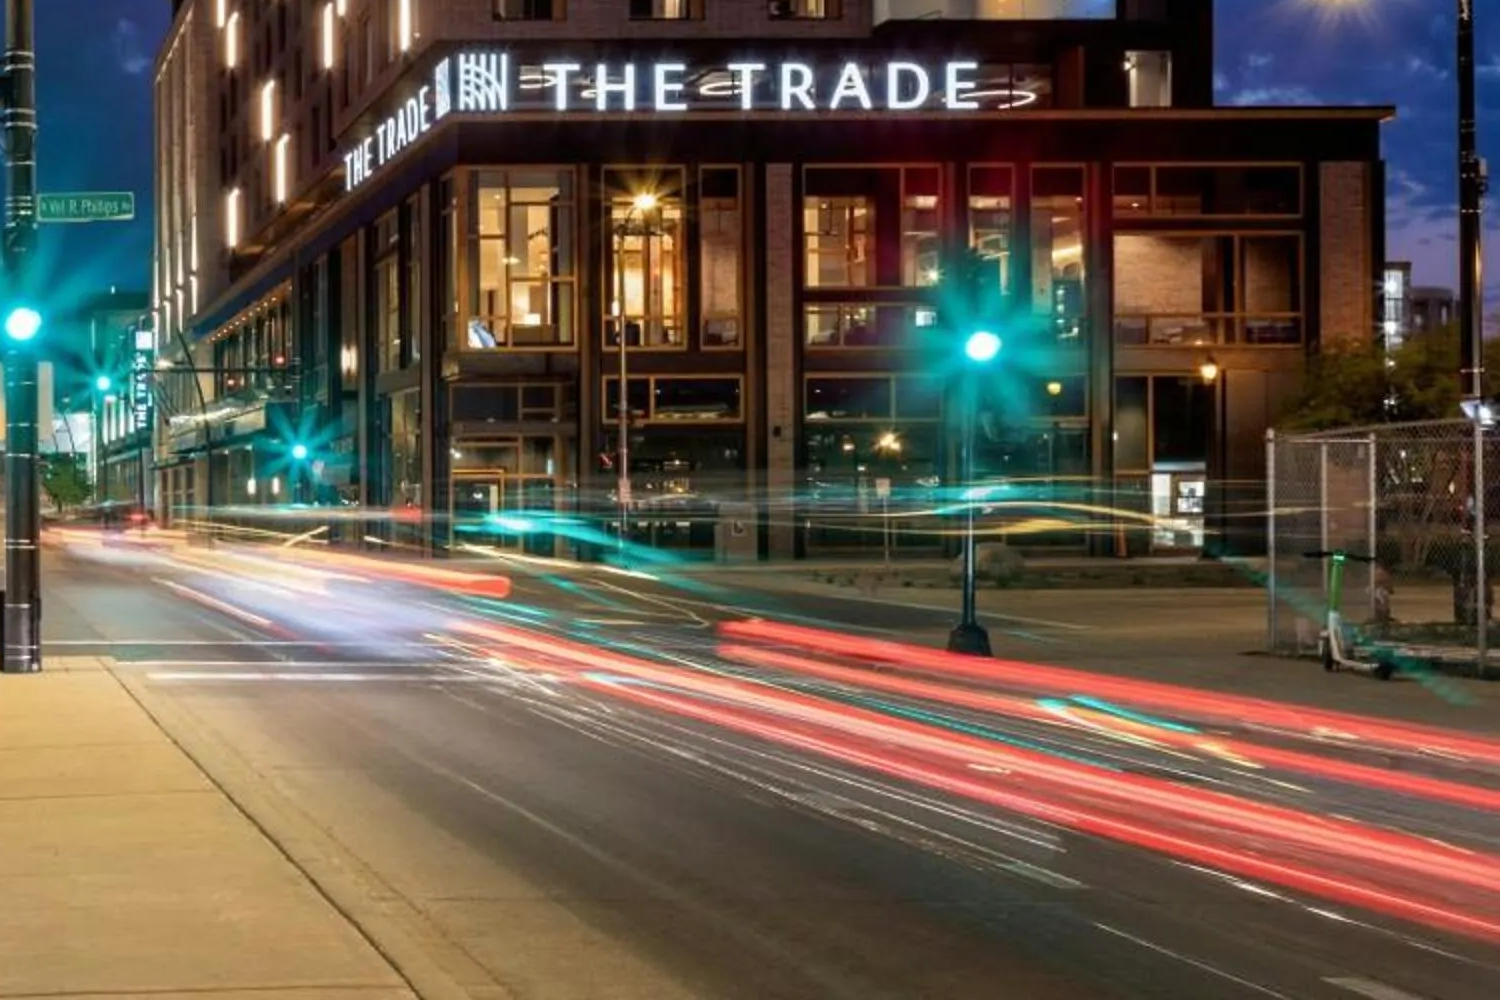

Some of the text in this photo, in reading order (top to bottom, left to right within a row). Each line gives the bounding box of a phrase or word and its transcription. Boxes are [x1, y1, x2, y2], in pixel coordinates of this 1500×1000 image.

[543, 61, 979, 111] THE TRADE
[343, 84, 431, 193] THE TRADE
